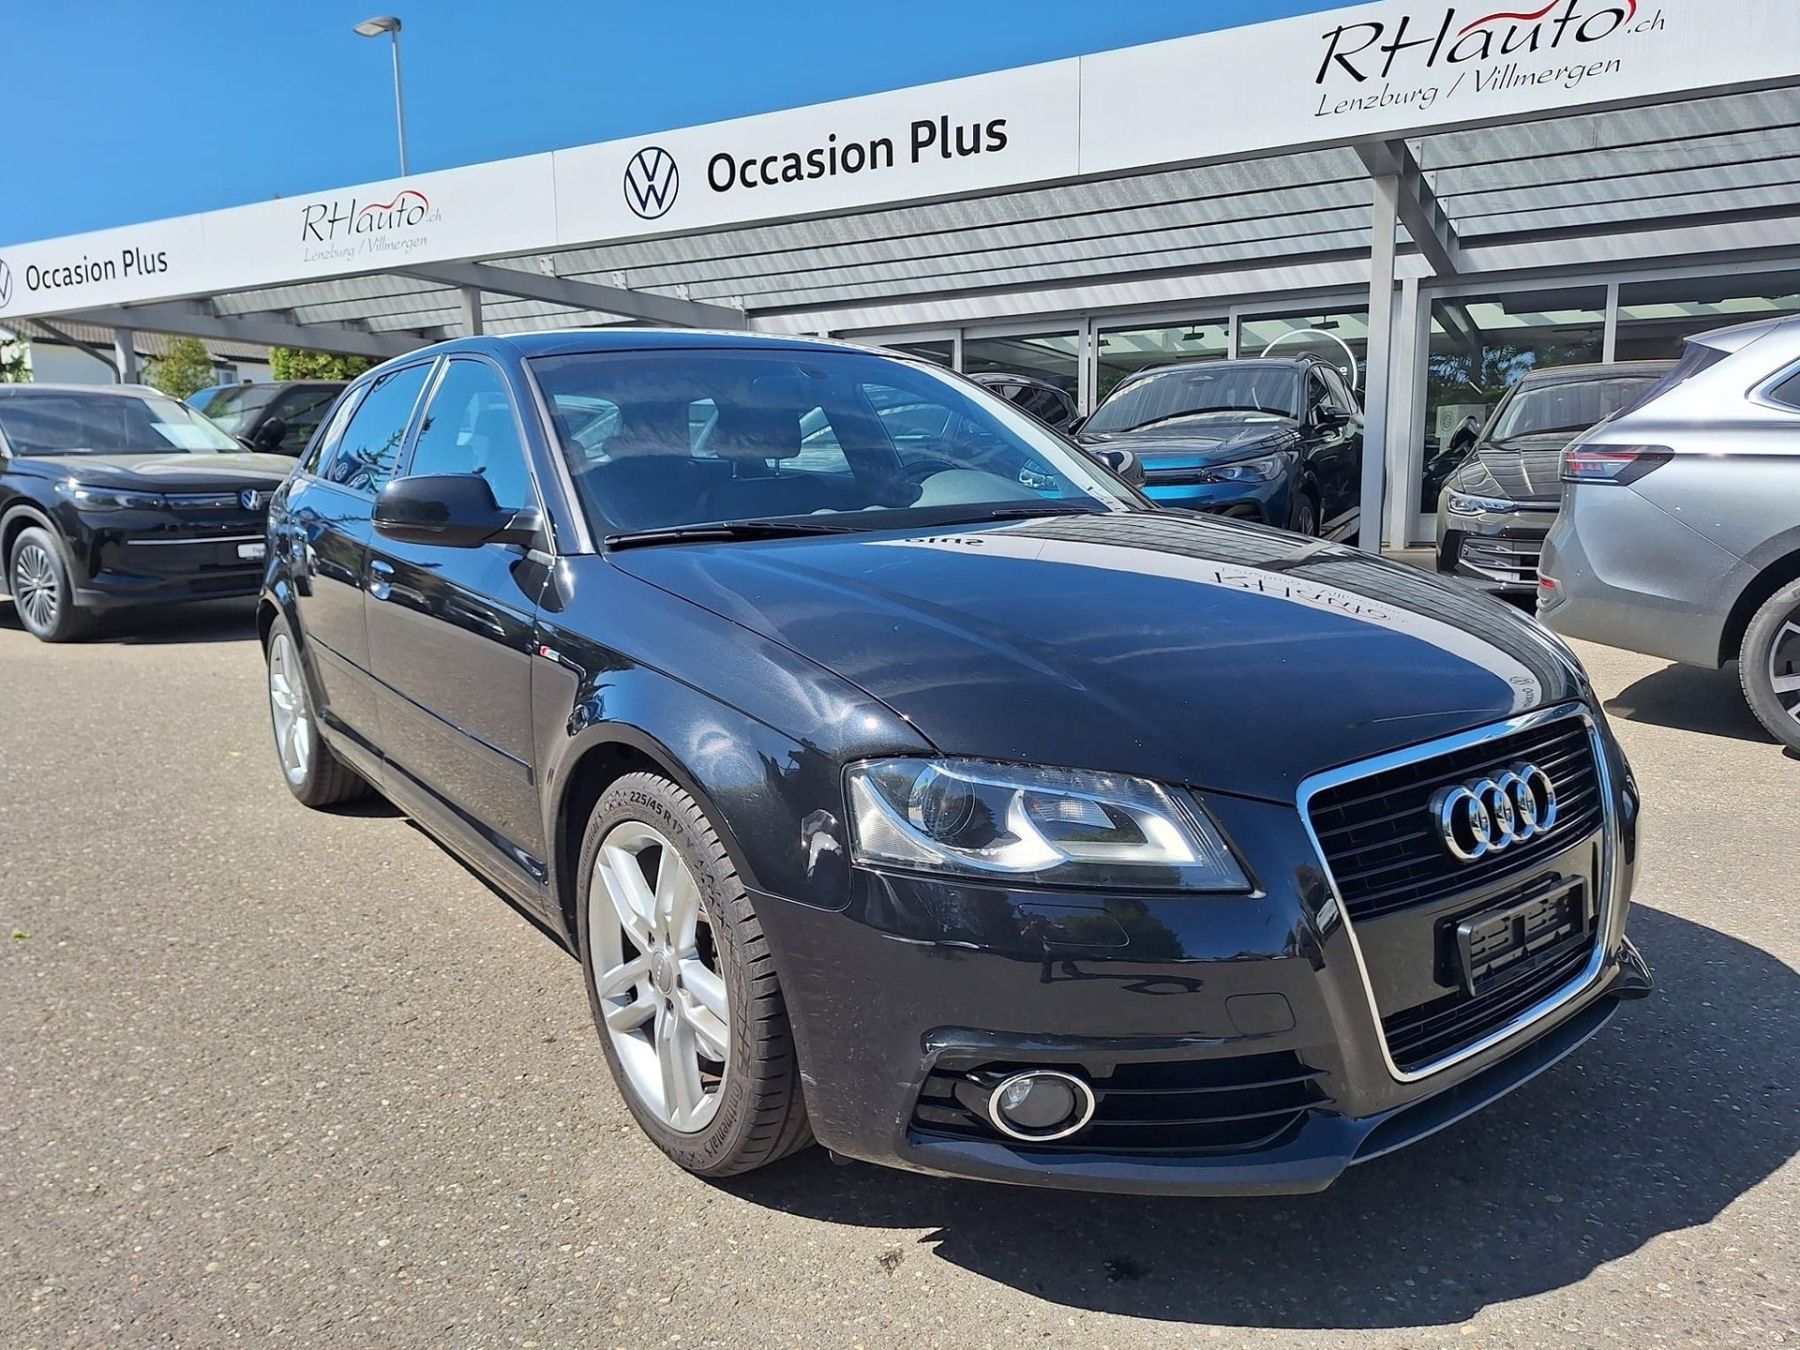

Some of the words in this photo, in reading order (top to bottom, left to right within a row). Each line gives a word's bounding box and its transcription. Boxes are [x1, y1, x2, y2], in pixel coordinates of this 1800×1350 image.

[1314, 82, 1439, 117] Lenzburg
[1474, 57, 1621, 92] Villmergen
[707, 133, 894, 193] Occasion
[910, 114, 1008, 164] Plus
[25, 254, 116, 292] Occasion
[122, 247, 168, 277] Plus
[303, 242, 355, 263] Lenzburg
[367, 234, 427, 254] Villmergen
[628, 790, 664, 816] 225/45
